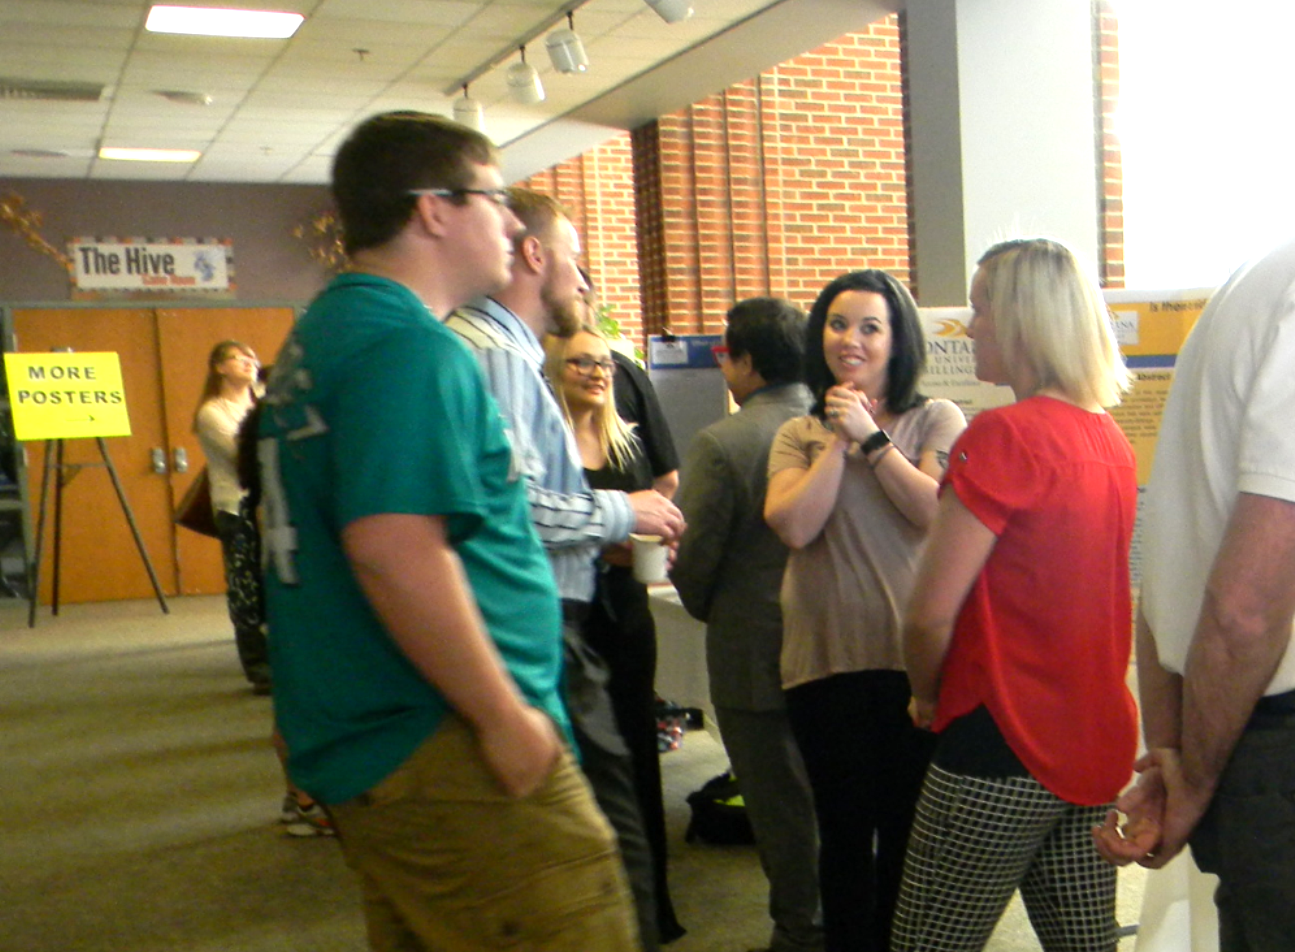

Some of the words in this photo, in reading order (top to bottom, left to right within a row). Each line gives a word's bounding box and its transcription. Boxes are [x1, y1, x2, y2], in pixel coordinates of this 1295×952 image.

[79, 247, 119, 274] The
[125, 247, 174, 274] Hive
[28, 366, 97, 380] MORE
[18, 389, 123, 405] POSTERS
